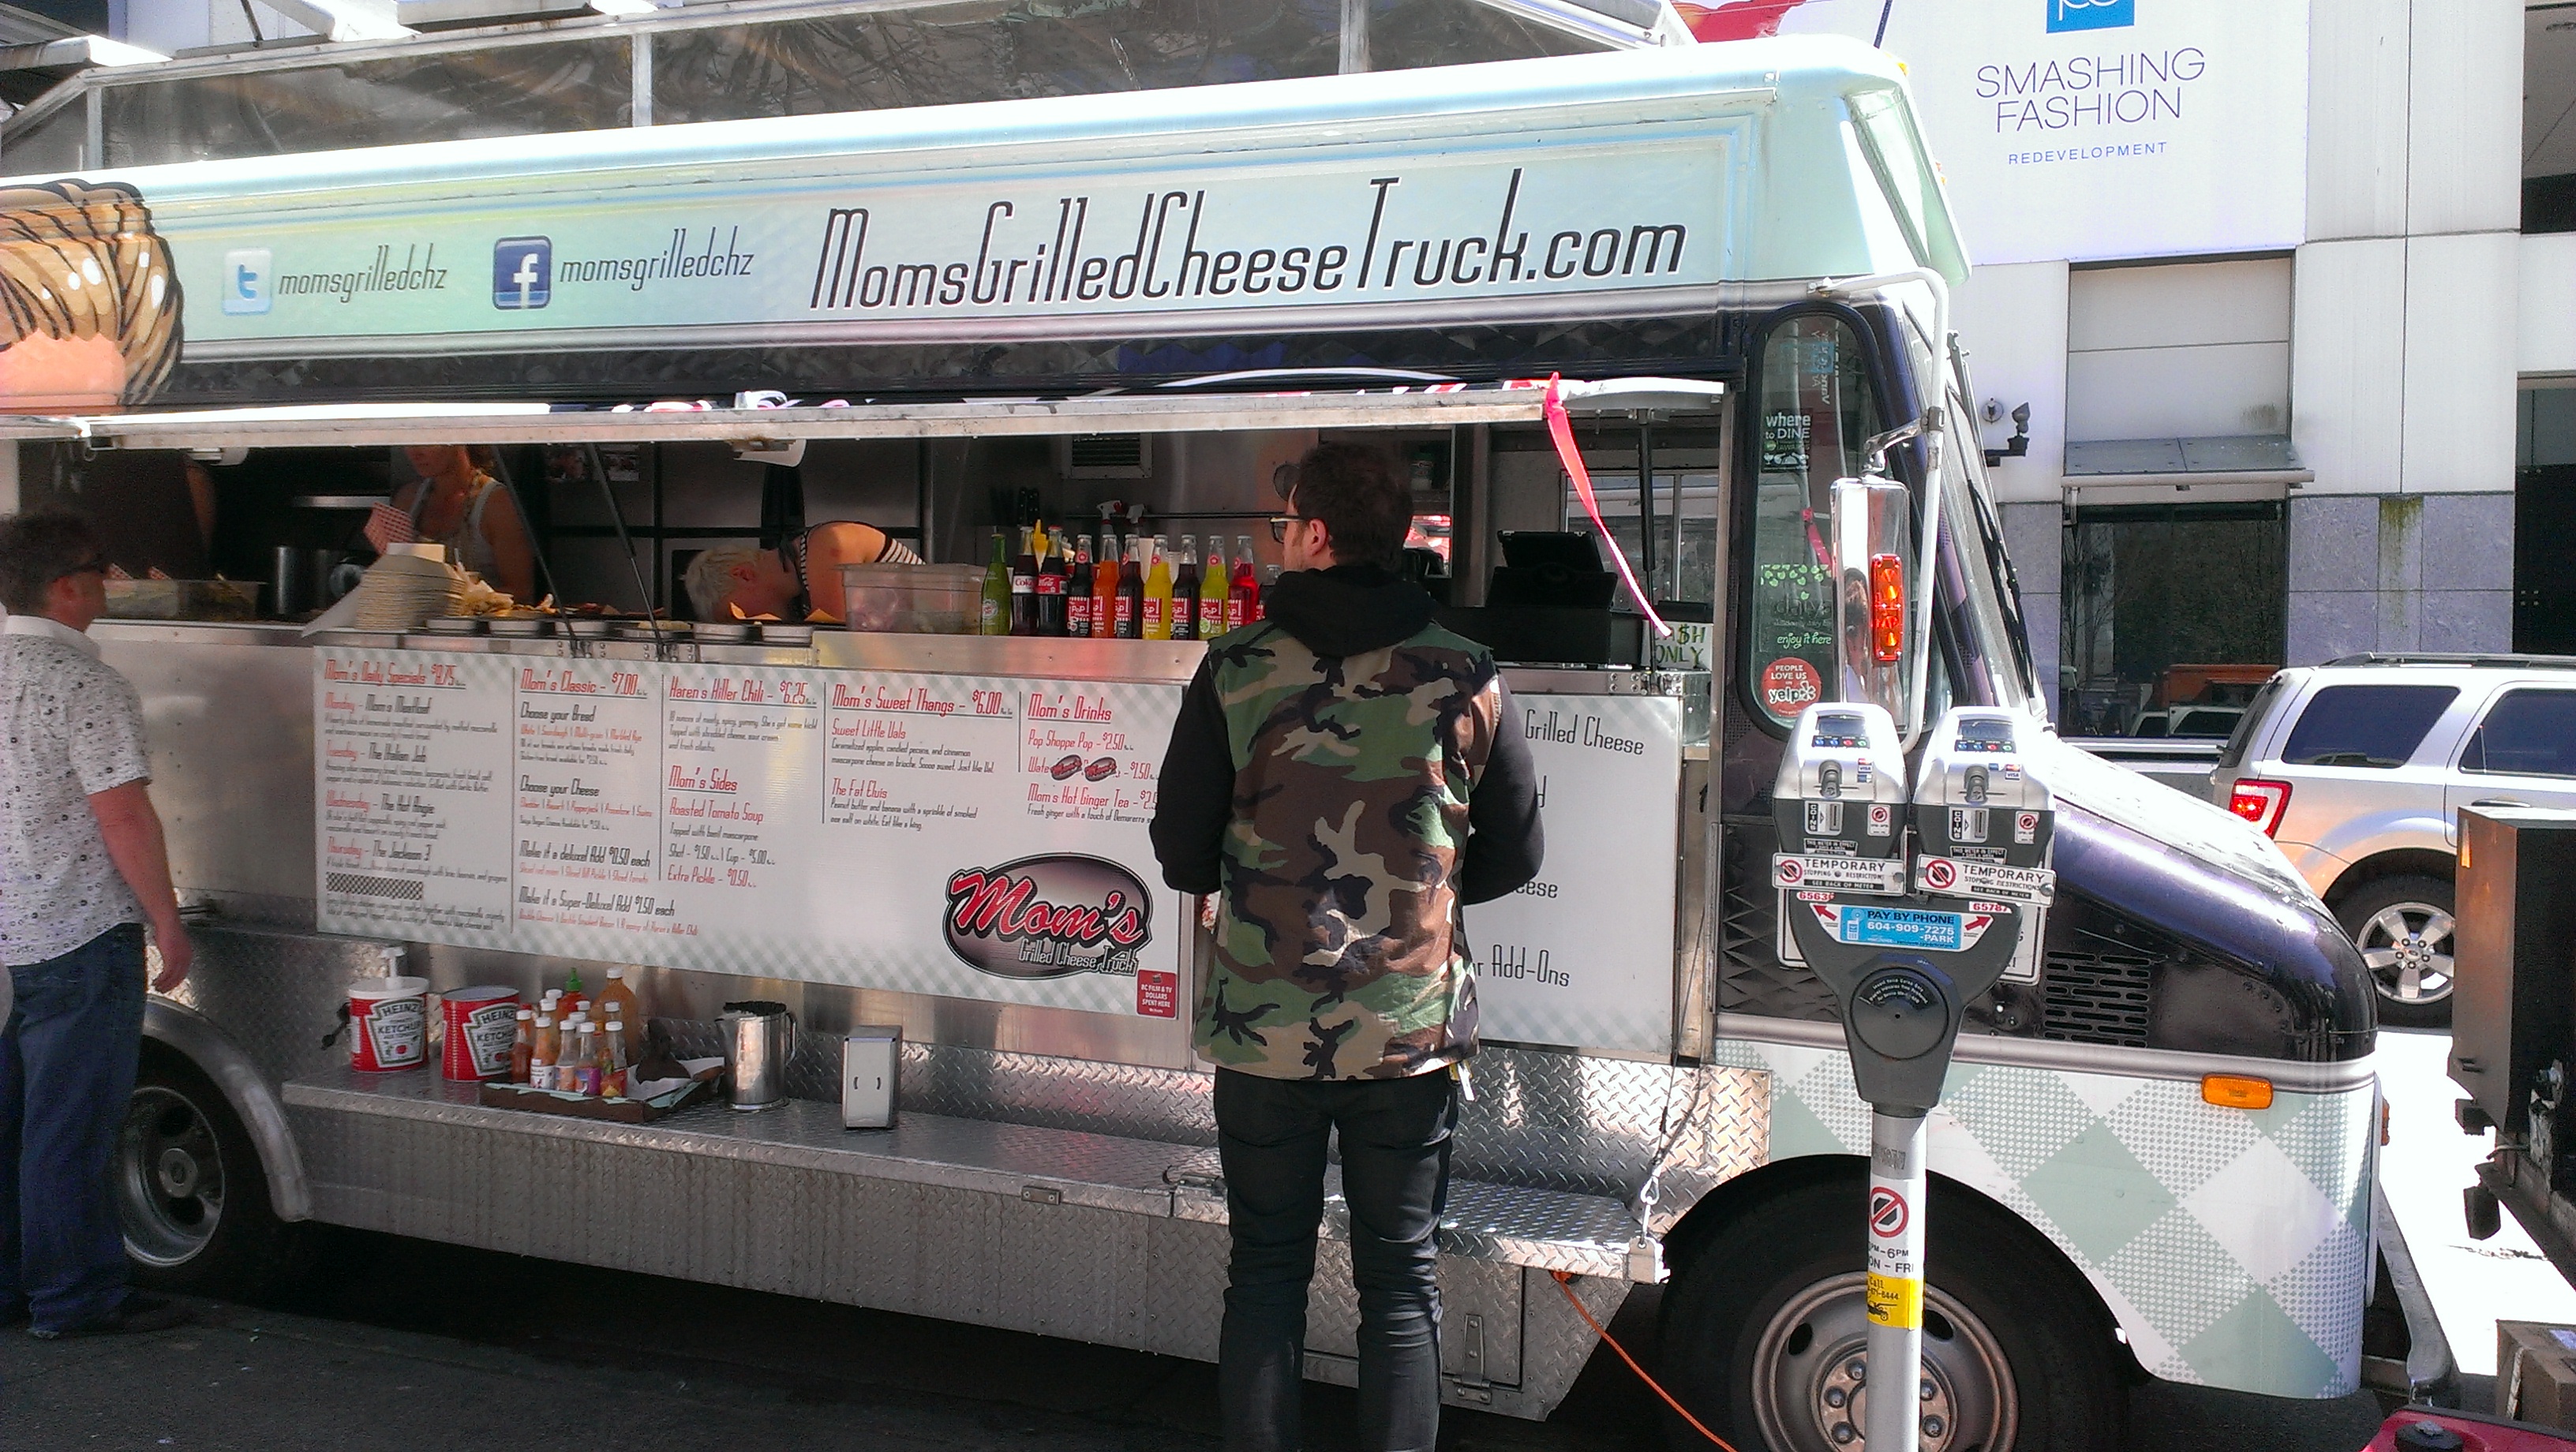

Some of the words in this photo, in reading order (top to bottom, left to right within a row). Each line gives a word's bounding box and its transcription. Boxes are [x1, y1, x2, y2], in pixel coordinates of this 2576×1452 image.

[1976, 47, 2205, 98] SMASHING
[1997, 87, 2181, 133] FASHION
[2009, 141, 2167, 165] REDEVELOPMENT
[811, 168, 1687, 312] MomsGrilledCheeseTruck.com
[560, 226, 755, 291] momsgrilledchz
[279, 244, 447, 304] momsgrilledchz
[1766, 412, 1811, 427] where
[1777, 428, 1810, 439] DINE
[1777, 633, 1802, 649] enjoy
[1803, 633, 1810, 644] it
[1811, 632, 1832, 644] here
[1655, 644, 1704, 669] ONLY
[520, 668, 557, 691] Mom's
[560, 671, 596, 693] Classic
[612, 672, 638, 695] $7.00
[741, 679, 765, 702] Chili
[780, 680, 808, 705] $6.25
[832, 683, 872, 708] Mom's
[875, 686, 913, 710] Sweet
[916, 687, 955, 717] Thangs
[972, 689, 1002, 715] $6.00
[1028, 693, 1069, 719] Mom's
[1074, 695, 1112, 721] Drinks
[1769, 687, 1800, 705] yelp
[520, 702, 548, 720] Choose
[550, 711, 569, 723] your
[832, 717, 861, 737] Sweet
[862, 719, 886, 738] Little
[1525, 709, 1578, 743] Grilled
[1584, 716, 1644, 755] Cheese
[1028, 728, 1043, 749] Pop
[1046, 729, 1076, 750] Shoppe
[1077, 732, 1093, 751] Pop
[1028, 756, 1050, 773] Wate
[520, 774, 548, 792] Choose
[550, 785, 569, 797] your
[571, 778, 600, 796] Cheese
[668, 765, 706, 789] Mom's
[710, 768, 738, 791] Sides
[832, 777, 847, 796] The
[848, 779, 865, 797] Fat
[1028, 783, 1059, 803] Moms
[1061, 786, 1079, 805] Hot
[1080, 787, 1110, 810] Ginger
[1114, 789, 1129, 808] Tea
[1140, 790, 1159, 810] $2.5
[670, 797, 706, 818] Roasted
[707, 799, 739, 820] Tomato
[742, 803, 763, 825] Soup
[1027, 803, 1045, 816] Fresh
[1046, 808, 1064, 820] ginger
[1065, 806, 1080, 819] with
[1087, 807, 1104, 820] touch
[1105, 809, 1113, 821] of
[1809, 804, 1818, 831] COINS
[1953, 811, 1962, 839] COINS
[630, 850, 650, 867] each
[1804, 859, 1886, 872] TEMPORARY
[668, 864, 689, 882] Extra
[1963, 864, 2045, 883] TEMPORARY
[655, 900, 675, 916] each
[951, 872, 1144, 945] Mom's
[1867, 909, 1892, 921] PAY
[1894, 911, 1911, 922] BY
[1913, 913, 1954, 925] PHONE
[1867, 922, 1954, 935] 604-909-7275
[1018, 937, 1055, 964] Grilled
[1055, 942, 1097, 969] Cheese
[1103, 945, 1137, 974] Truck
[1492, 944, 1570, 987] Add-Ons
[382, 1003, 421, 1016] HEINZ
[1895, 1263, 1914, 1273] FRI
